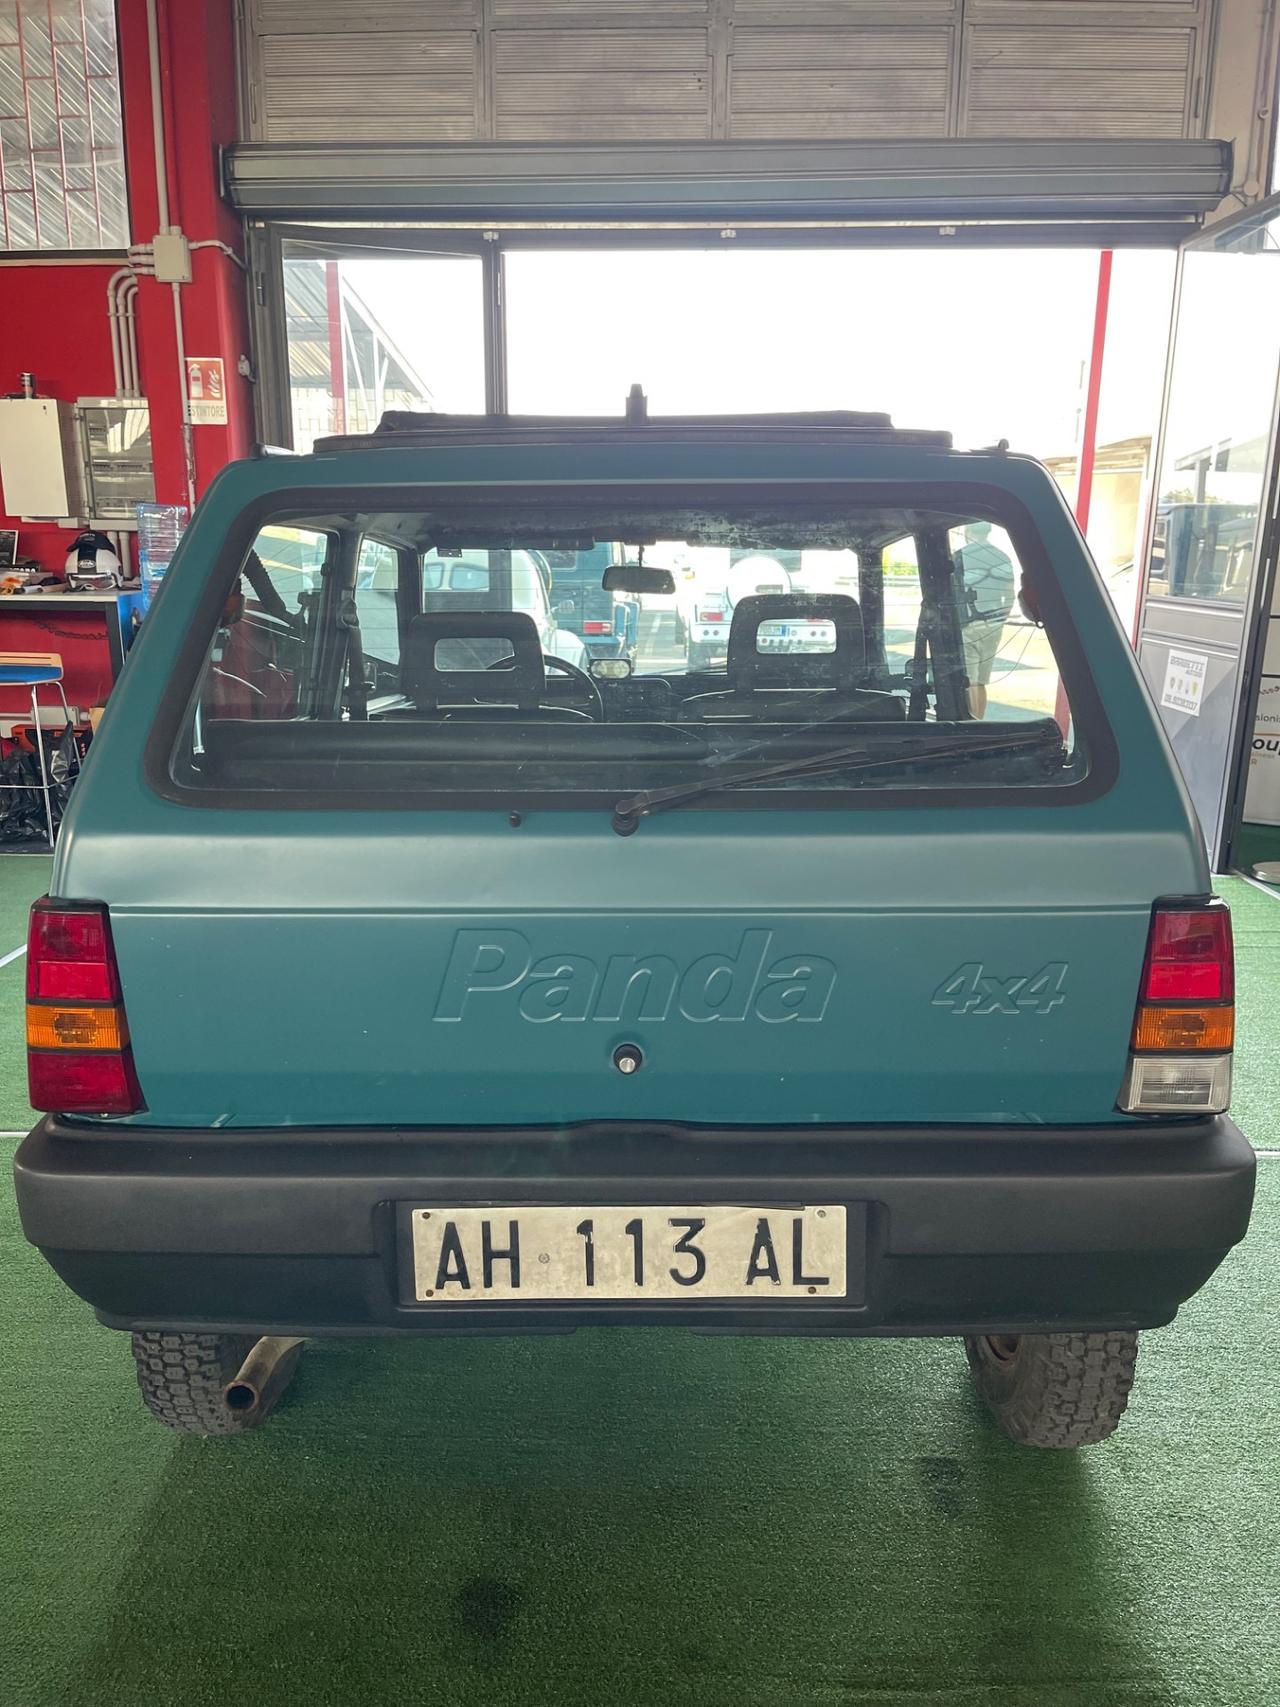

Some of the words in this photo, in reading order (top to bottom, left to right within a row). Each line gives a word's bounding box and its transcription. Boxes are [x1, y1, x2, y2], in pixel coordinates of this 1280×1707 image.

[1252, 738, 1280, 755] ou
[432, 928, 838, 1023] Panda
[931, 961, 1069, 1015] 4x4
[435, 1220, 520, 1290] AH
[576, 1218, 706, 1287] 113
[745, 1217, 830, 1286] AL
